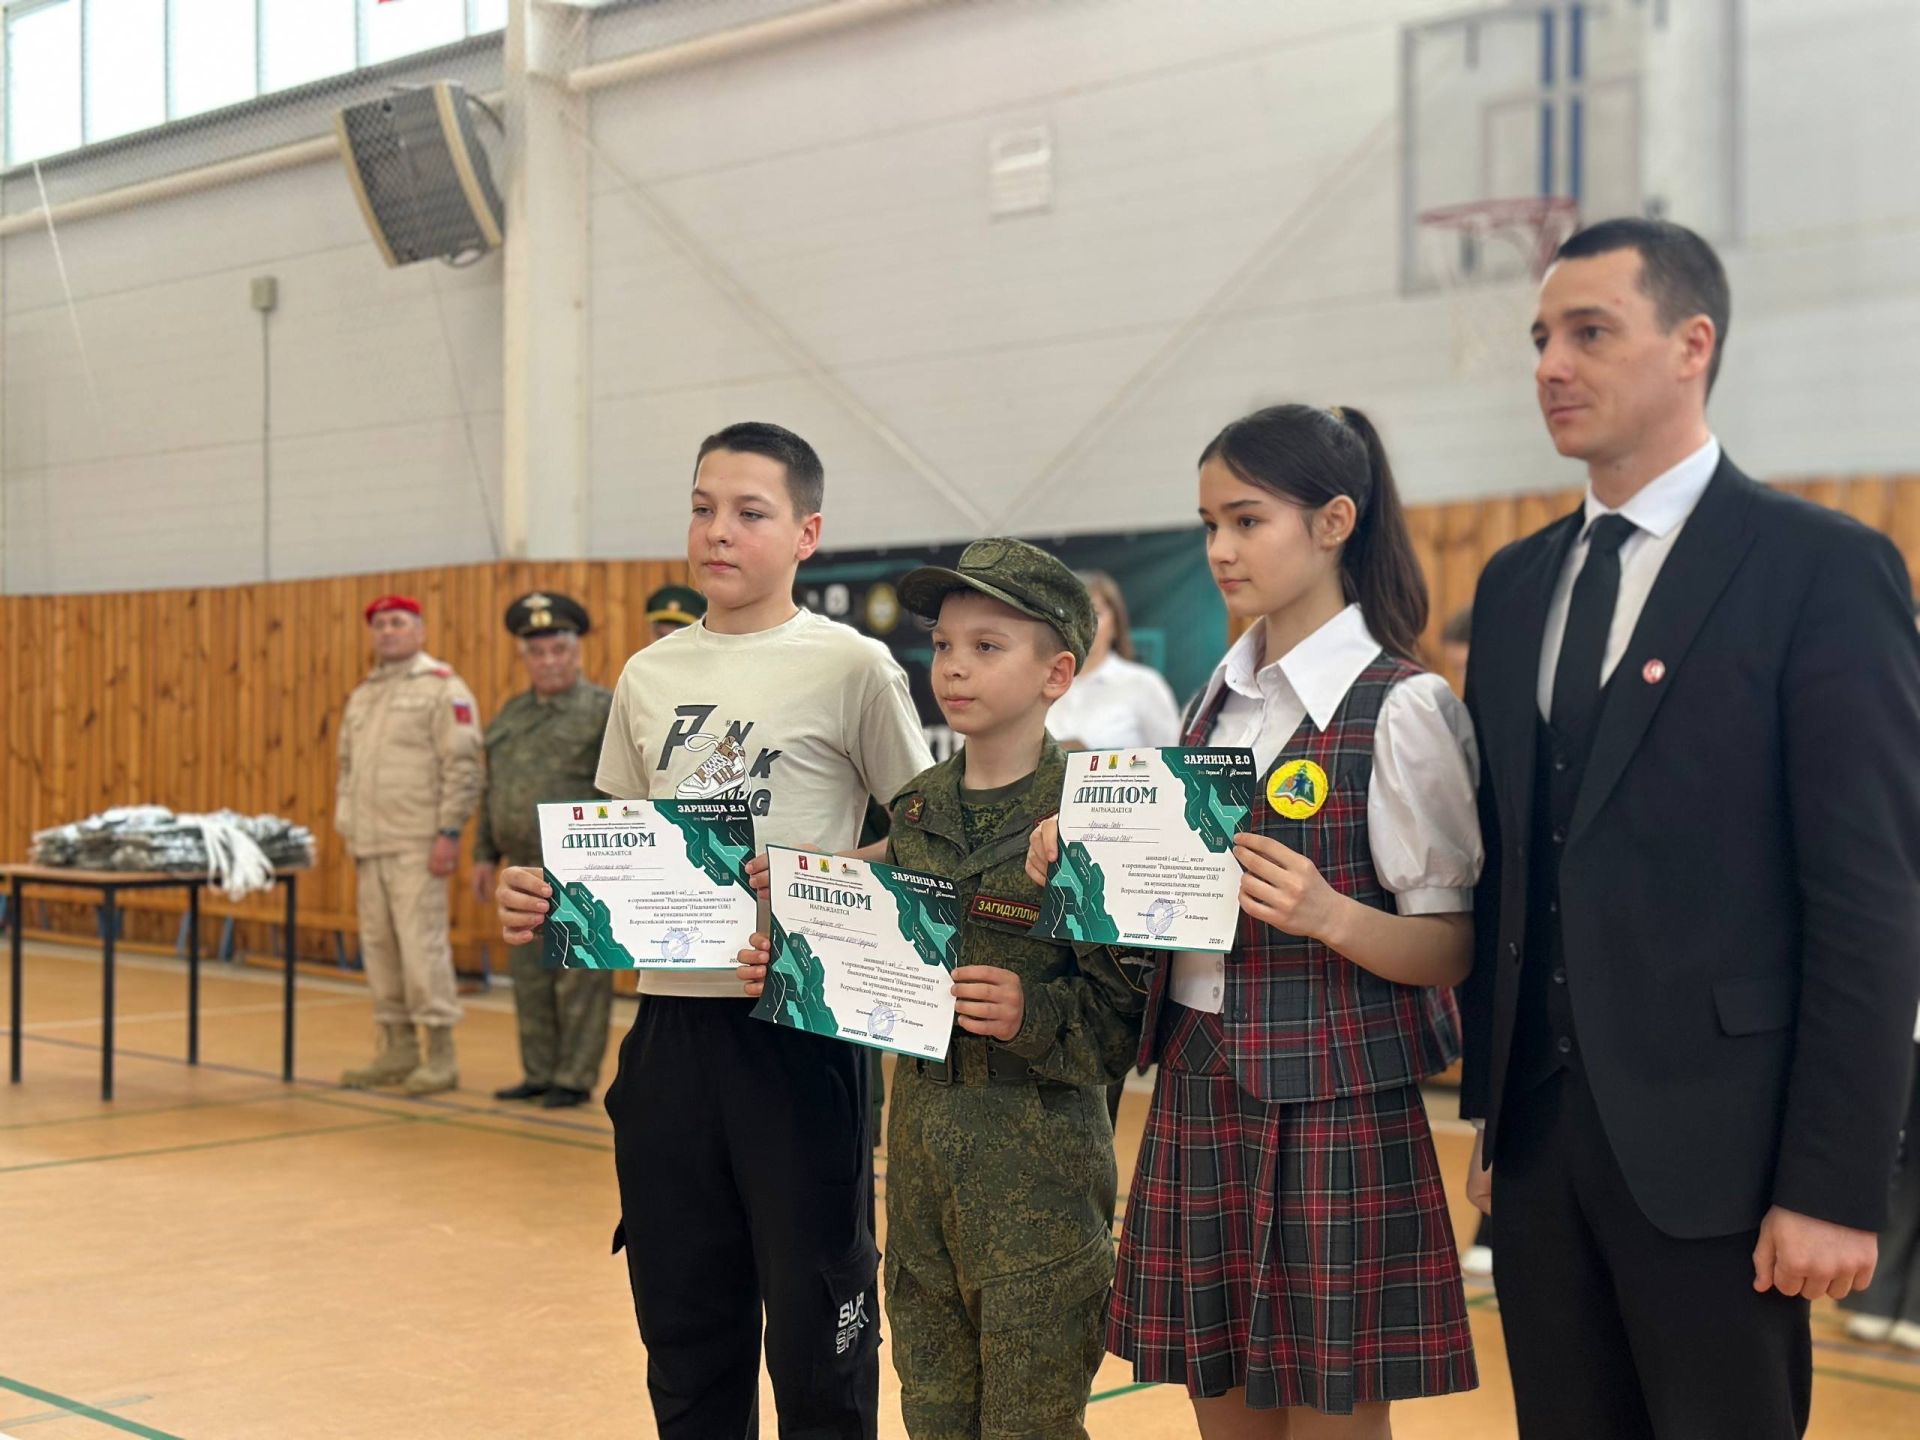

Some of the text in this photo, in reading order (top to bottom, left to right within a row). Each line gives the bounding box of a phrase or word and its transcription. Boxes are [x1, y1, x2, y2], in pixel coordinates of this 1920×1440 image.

[1184, 754, 1250, 766] ЗАРНИЦА 2.0
[1073, 786, 1158, 804] ДИПЛОМ
[677, 804, 727, 813] ЗАРНИЦА
[562, 832, 656, 848] ДИПЛОМ
[891, 871, 953, 890] ЗАРНИЦА 2.0
[788, 882, 872, 911] ДИПЛОМ
[809, 903, 850, 915] НАГРАЖДАЕТСЯ
